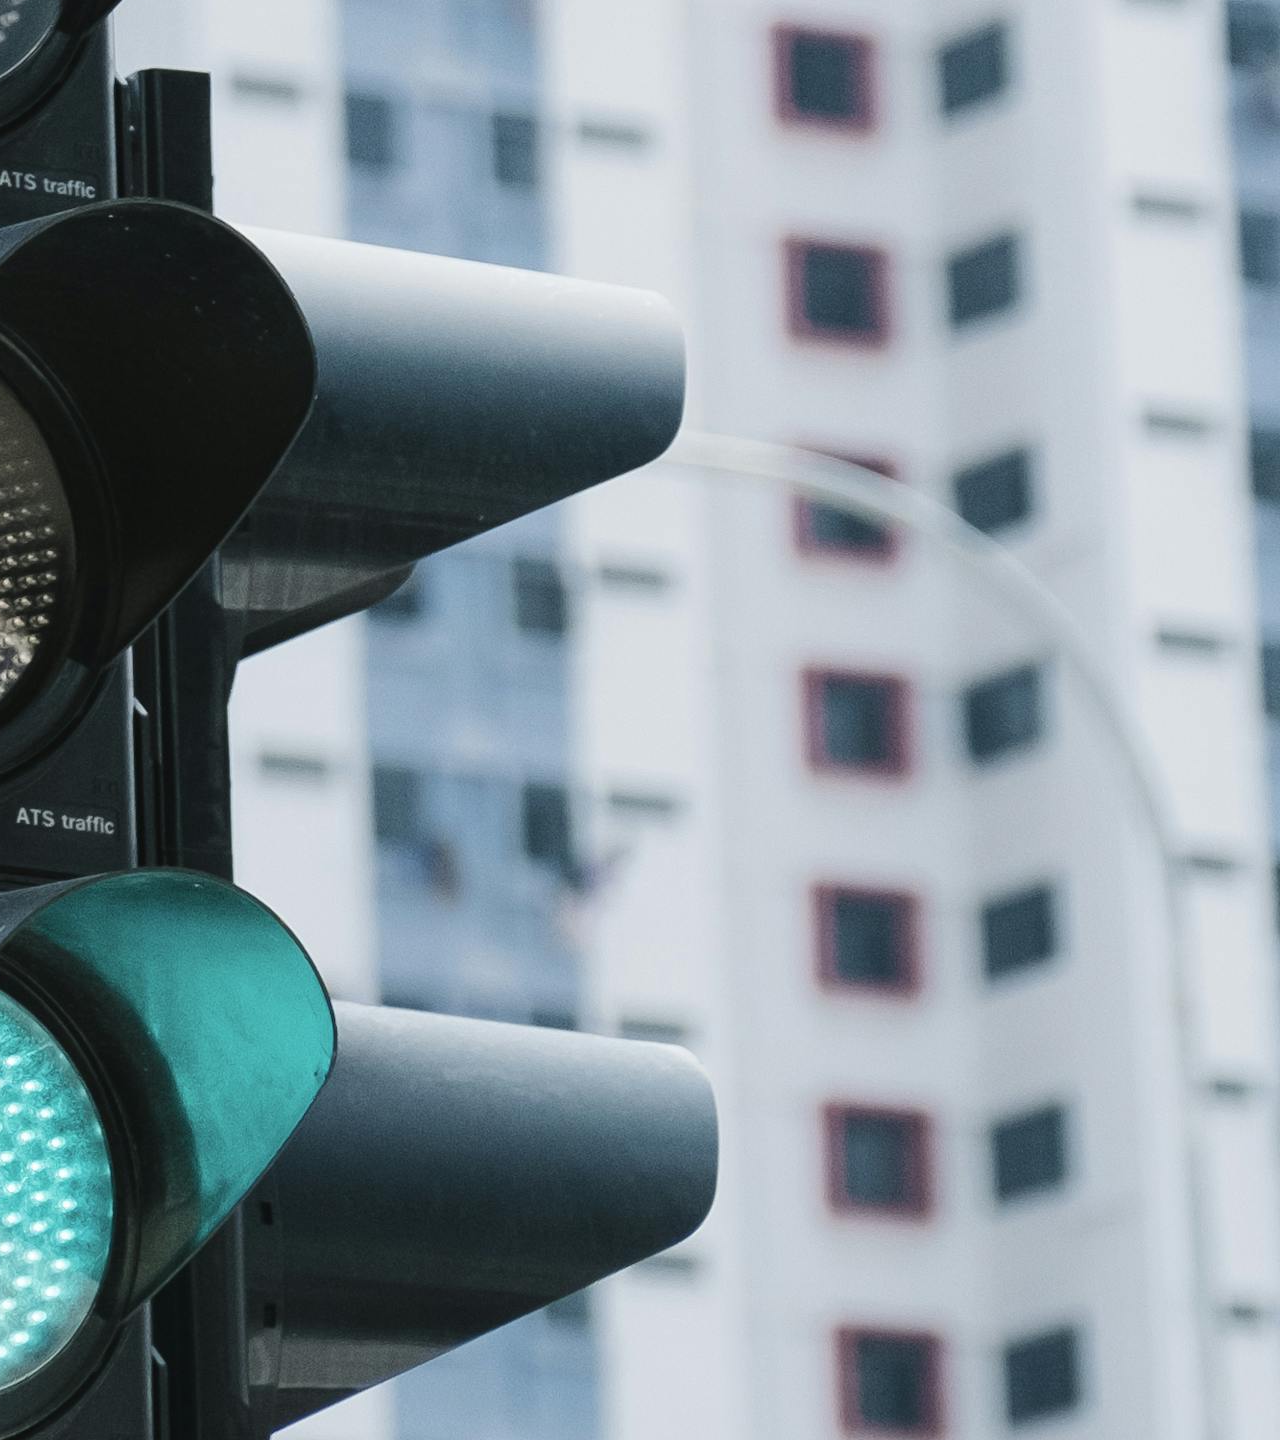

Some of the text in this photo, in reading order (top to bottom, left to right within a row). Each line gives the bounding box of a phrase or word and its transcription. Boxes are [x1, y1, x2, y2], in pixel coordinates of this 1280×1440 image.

[43, 178, 96, 198] traffic
[16, 807, 115, 835] ATS traffic
